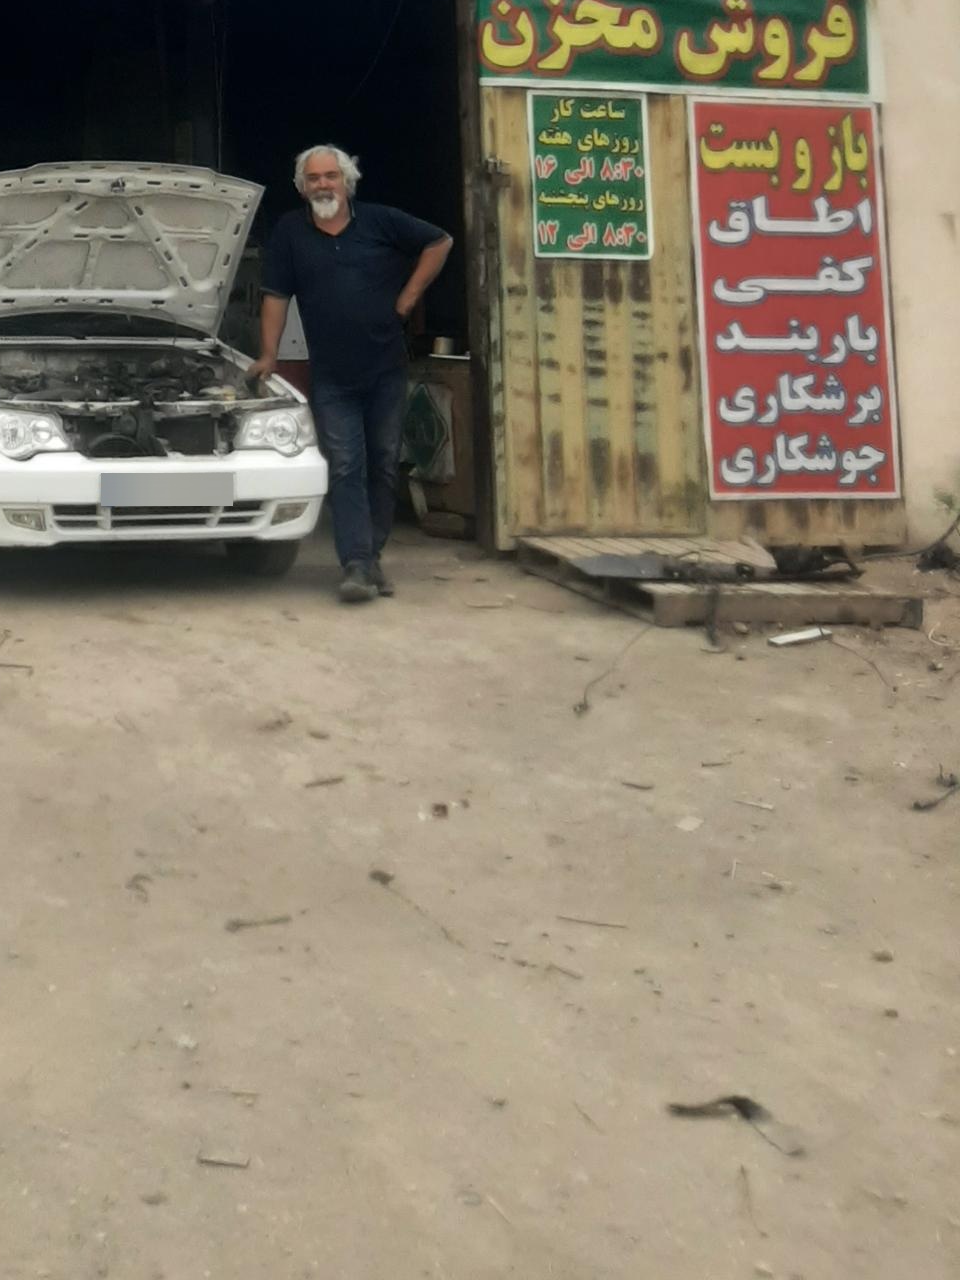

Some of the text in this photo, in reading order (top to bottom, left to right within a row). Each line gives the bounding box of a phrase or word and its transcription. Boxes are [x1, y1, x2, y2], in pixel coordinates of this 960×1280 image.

[550, 99, 625, 122] ساعت کار
[538, 127, 640, 153] روزهای هفته
[700, 114, 868, 190] باز و بست
[565, 157, 595, 185] الی
[567, 222, 597, 250] الی
[708, 195, 872, 244] اطاق
[713, 256, 873, 303] کفی
[719, 373, 881, 424] برشکاری
[721, 434, 885, 484] جوشکاری
